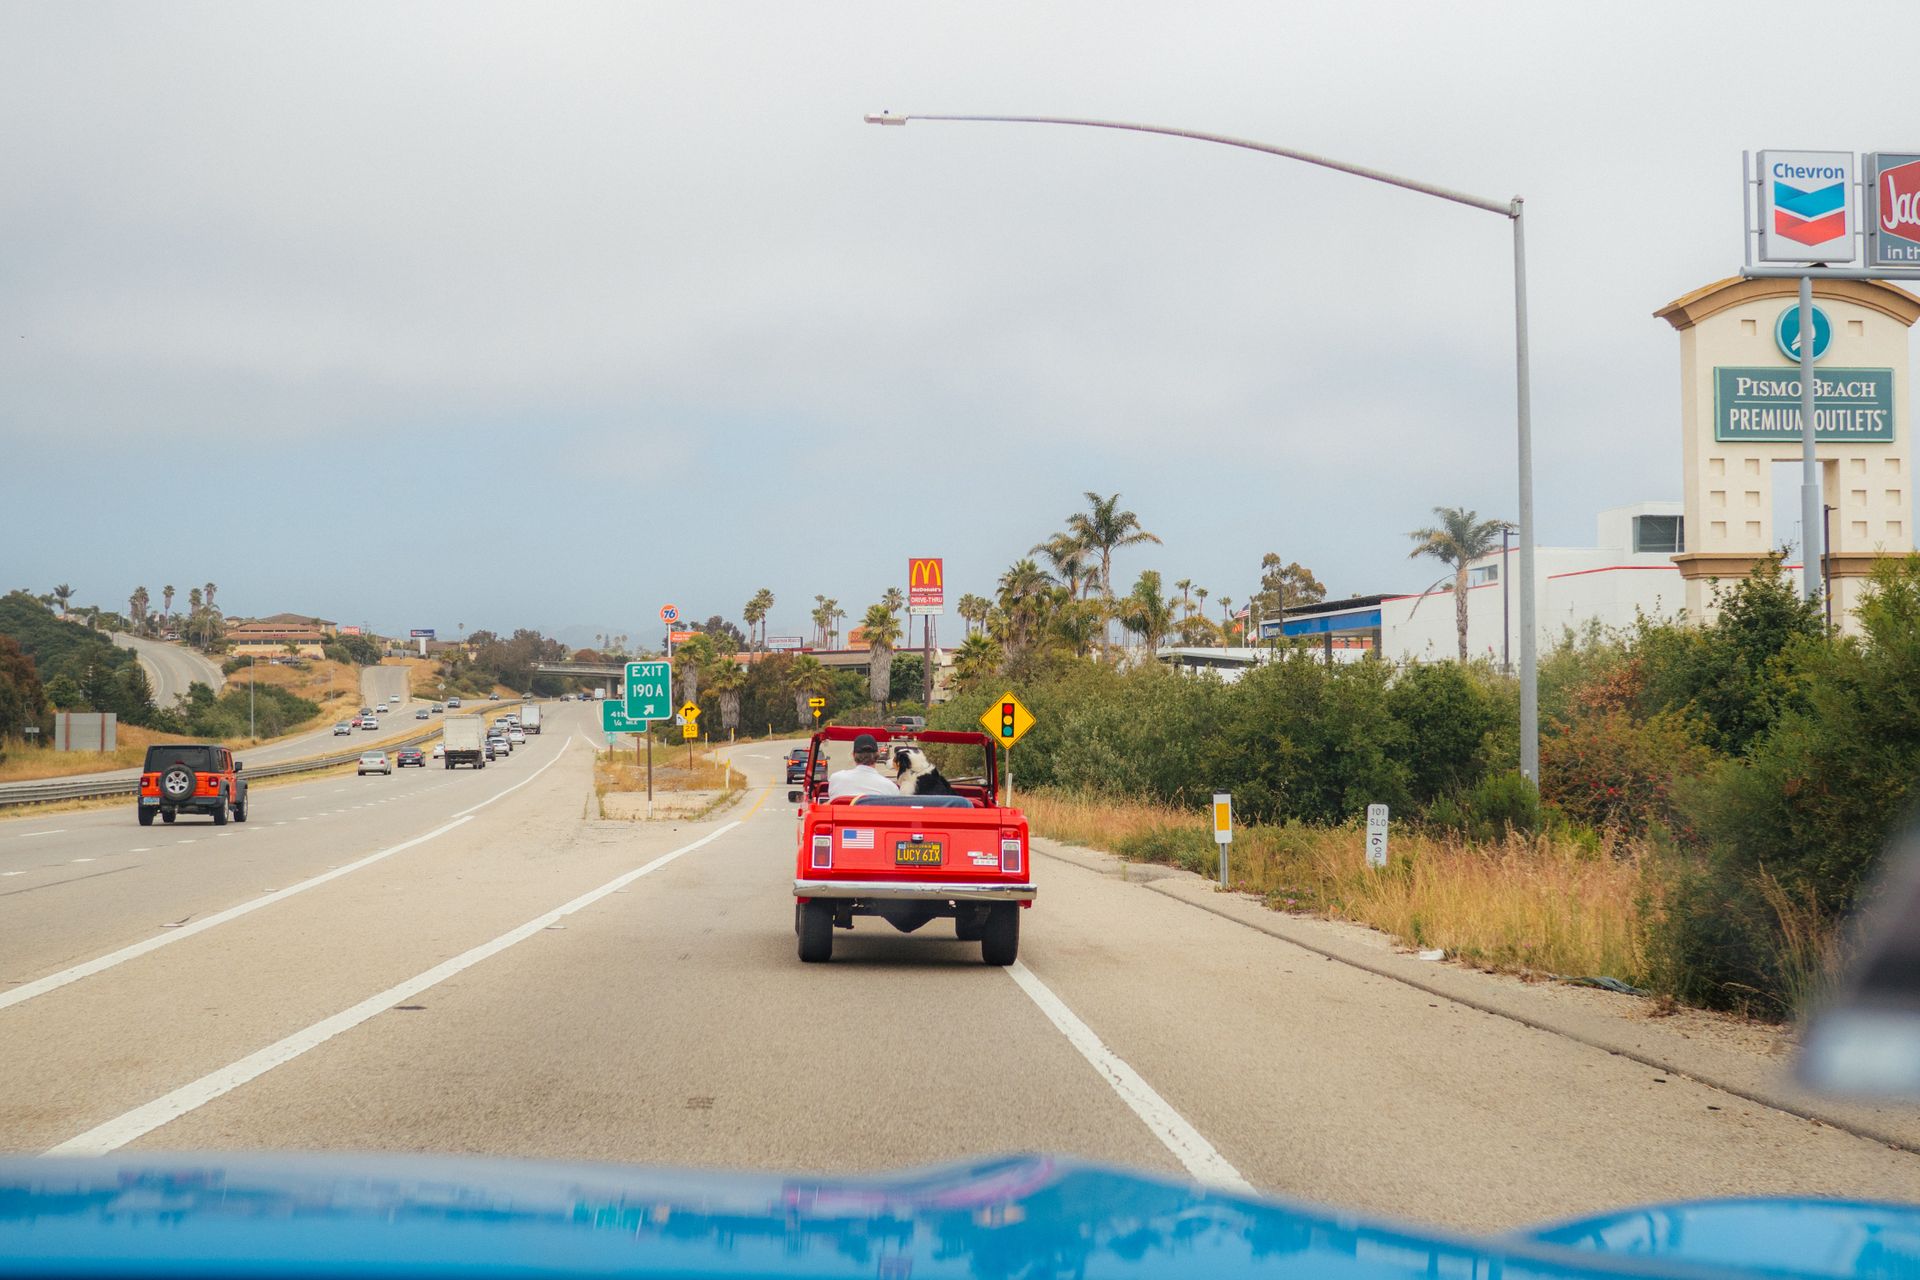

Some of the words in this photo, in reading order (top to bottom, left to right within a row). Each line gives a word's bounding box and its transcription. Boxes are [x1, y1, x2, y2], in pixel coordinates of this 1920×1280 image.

[1773, 162, 1845, 179] Chevron
[1887, 245, 1903, 259] in
[1736, 377, 1803, 397] PISMO
[663, 609, 676, 619] 76
[631, 665, 664, 677] EXIT
[1372, 808, 1385, 816] 101
[1370, 818, 1387, 827] SLO
[897, 849, 920, 861] LUCY
